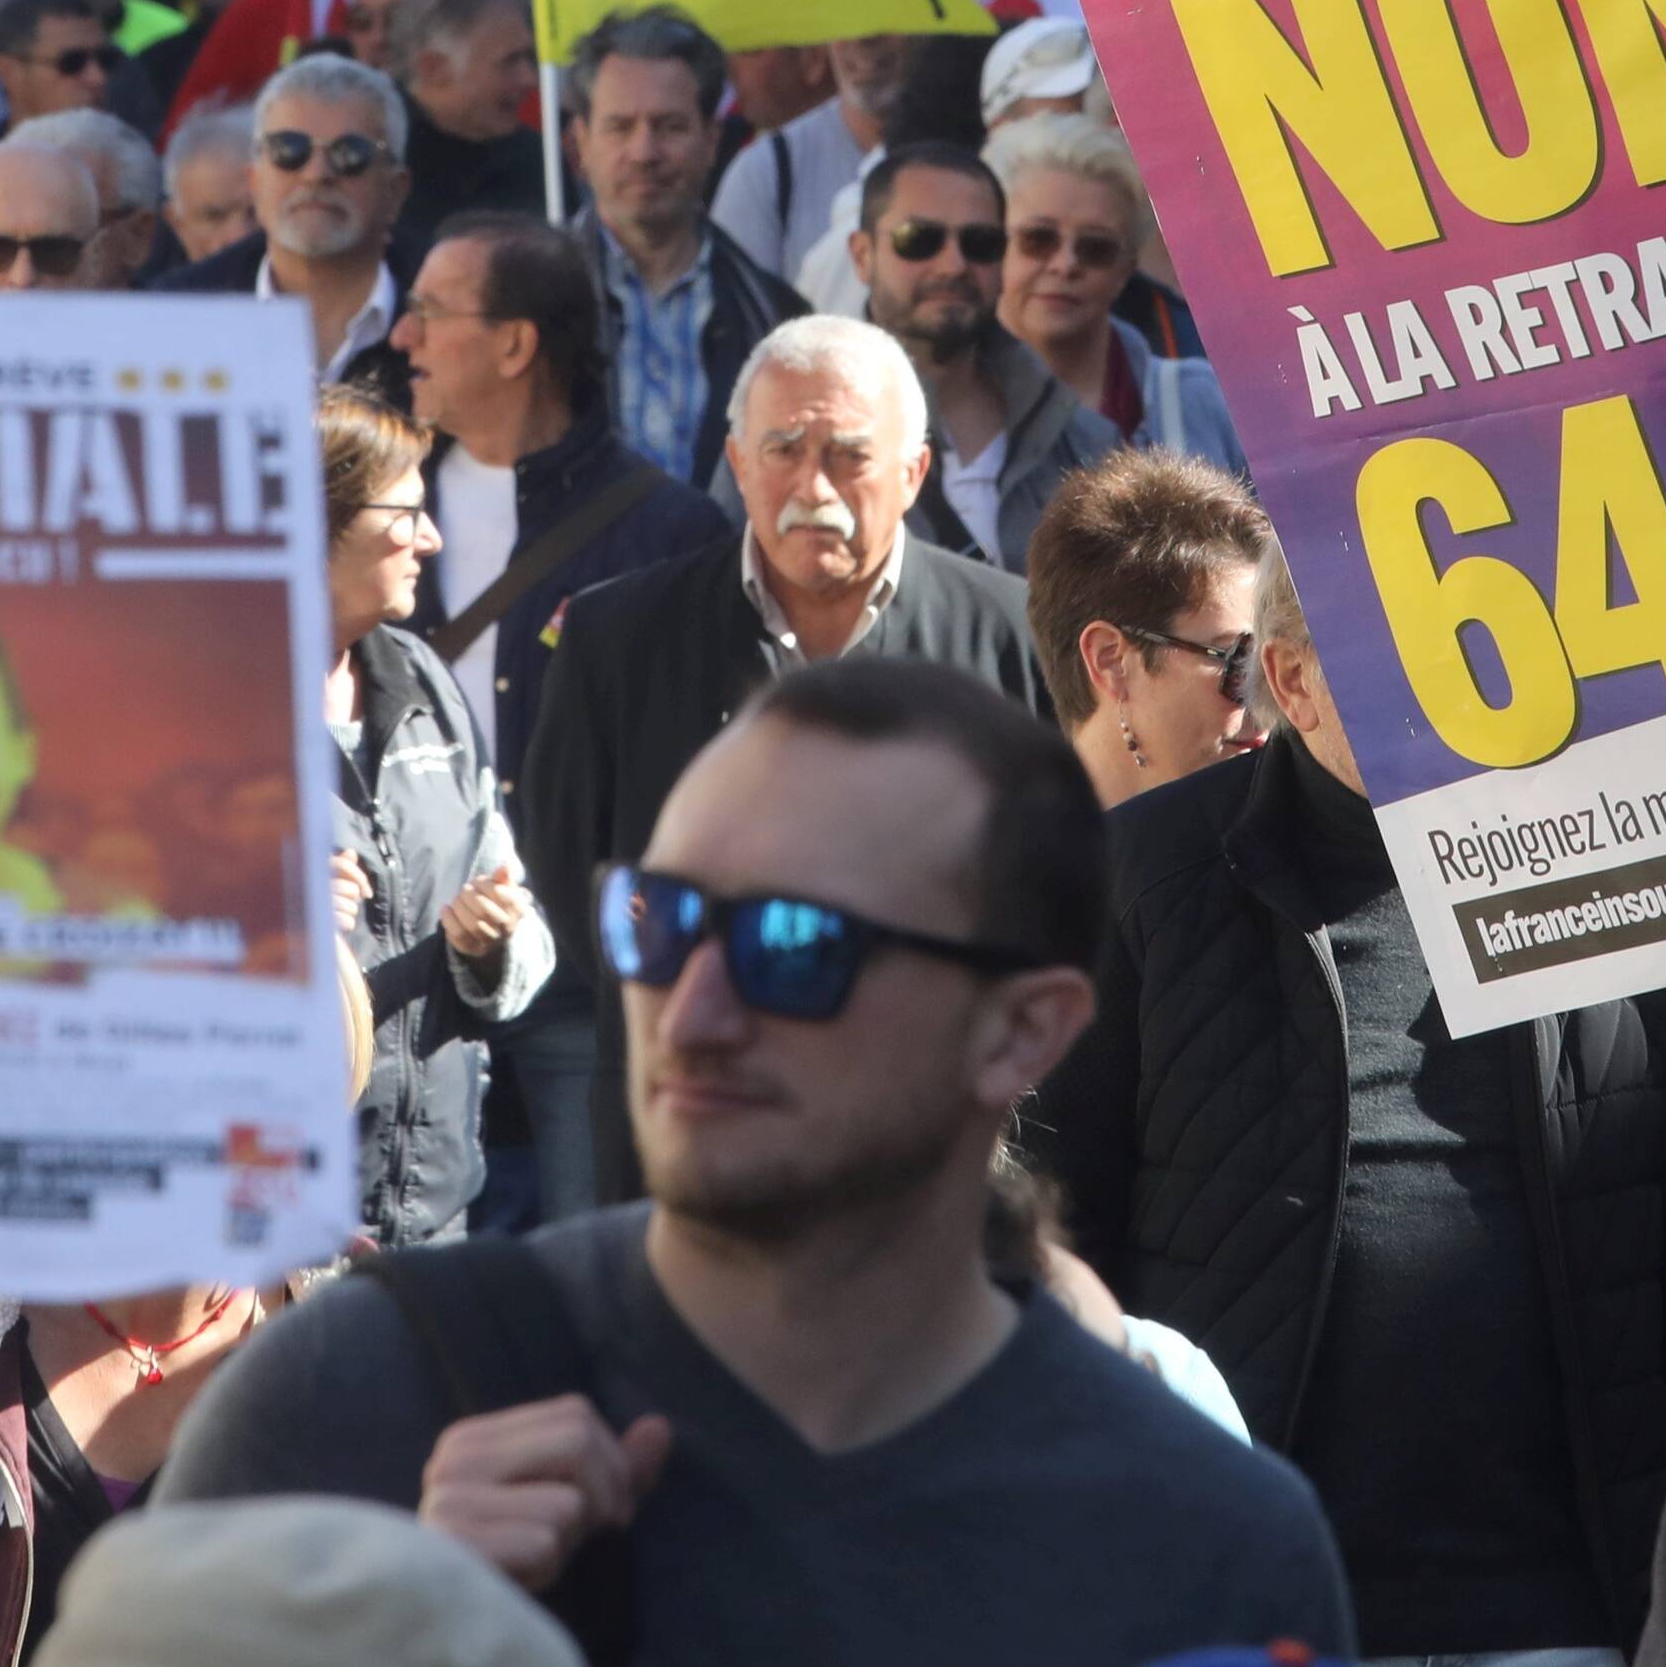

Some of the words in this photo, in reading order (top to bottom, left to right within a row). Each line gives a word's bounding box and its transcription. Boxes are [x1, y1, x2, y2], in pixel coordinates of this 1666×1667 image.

[1287, 305, 1362, 419] À
[1351, 300, 1457, 407] LA
[1427, 801, 1607, 885] Rejoignez
[1605, 790, 1646, 847] la
